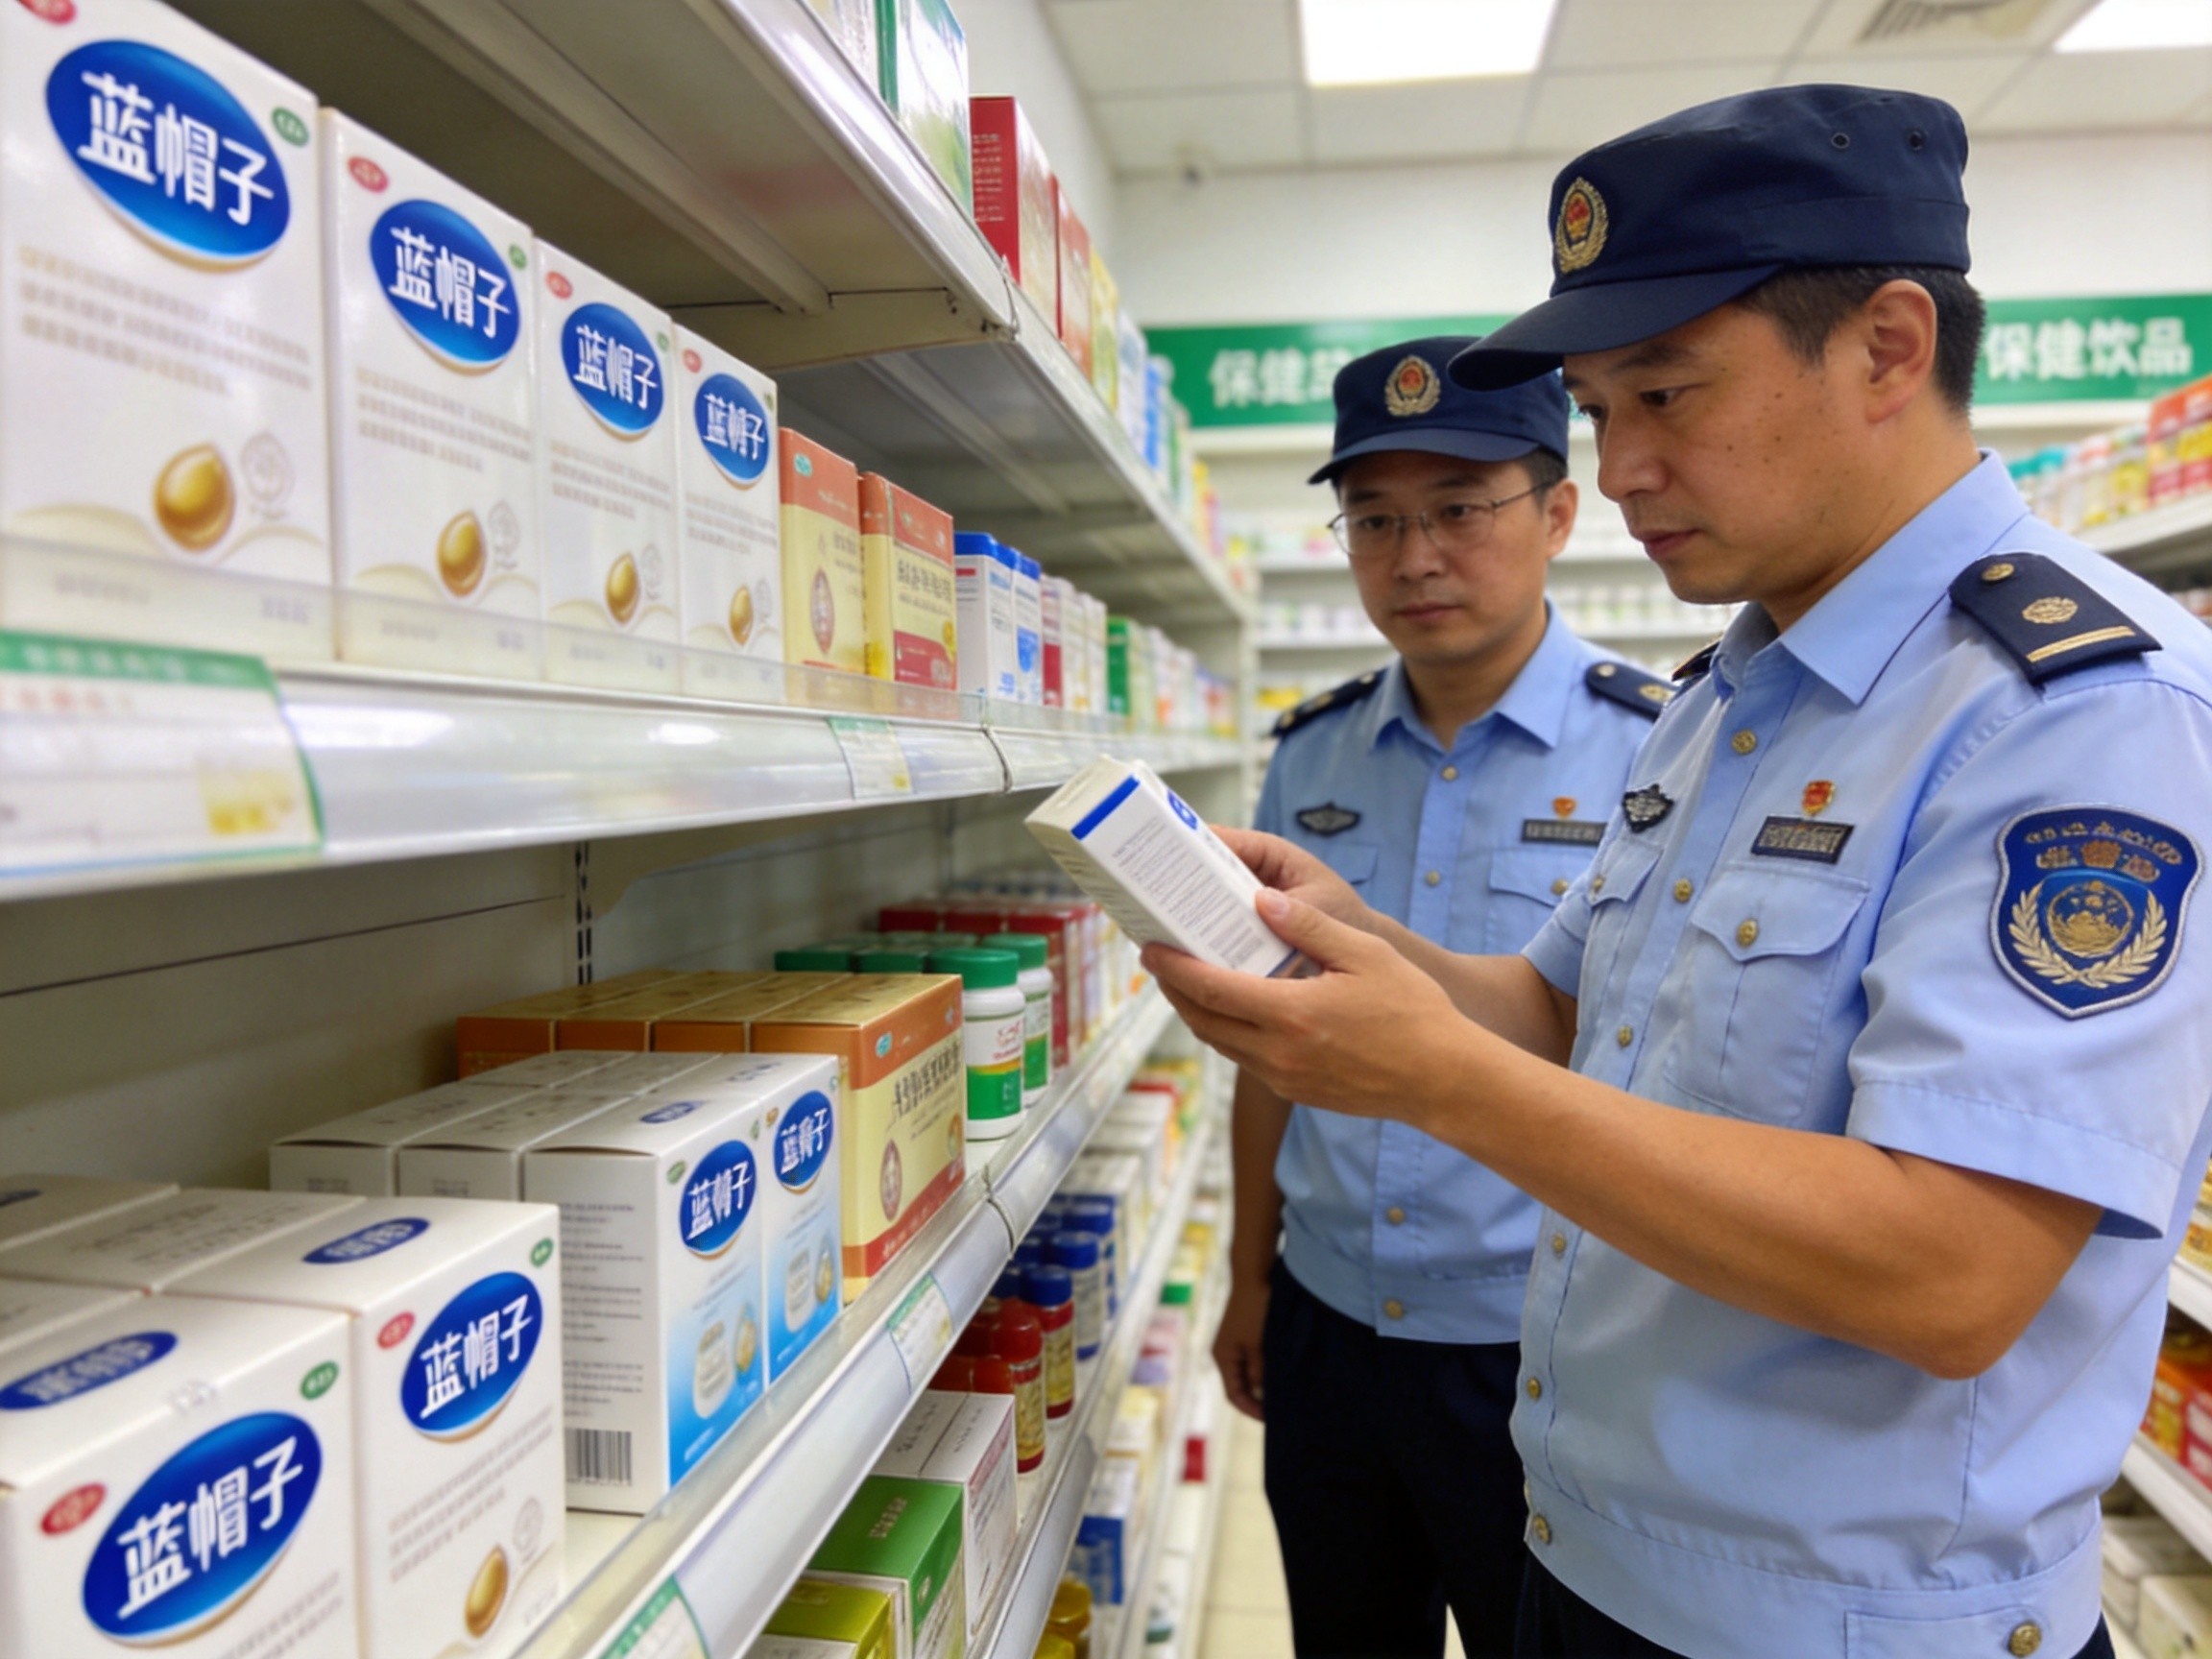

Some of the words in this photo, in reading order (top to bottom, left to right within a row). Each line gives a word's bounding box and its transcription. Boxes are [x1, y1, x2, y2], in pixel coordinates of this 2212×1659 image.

[79, 71, 275, 227] 蓝帽子
[389, 226, 513, 339] 蓝帽子
[573, 324, 659, 410] 蓝帽子
[1984, 317, 2193, 381] 保健饮品
[704, 394, 764, 460] 蓝帽子
[686, 1160, 751, 1239] 蓝帽子
[420, 1292, 534, 1418] 蓝帽子
[116, 1434, 304, 1620] 蓝帽子
